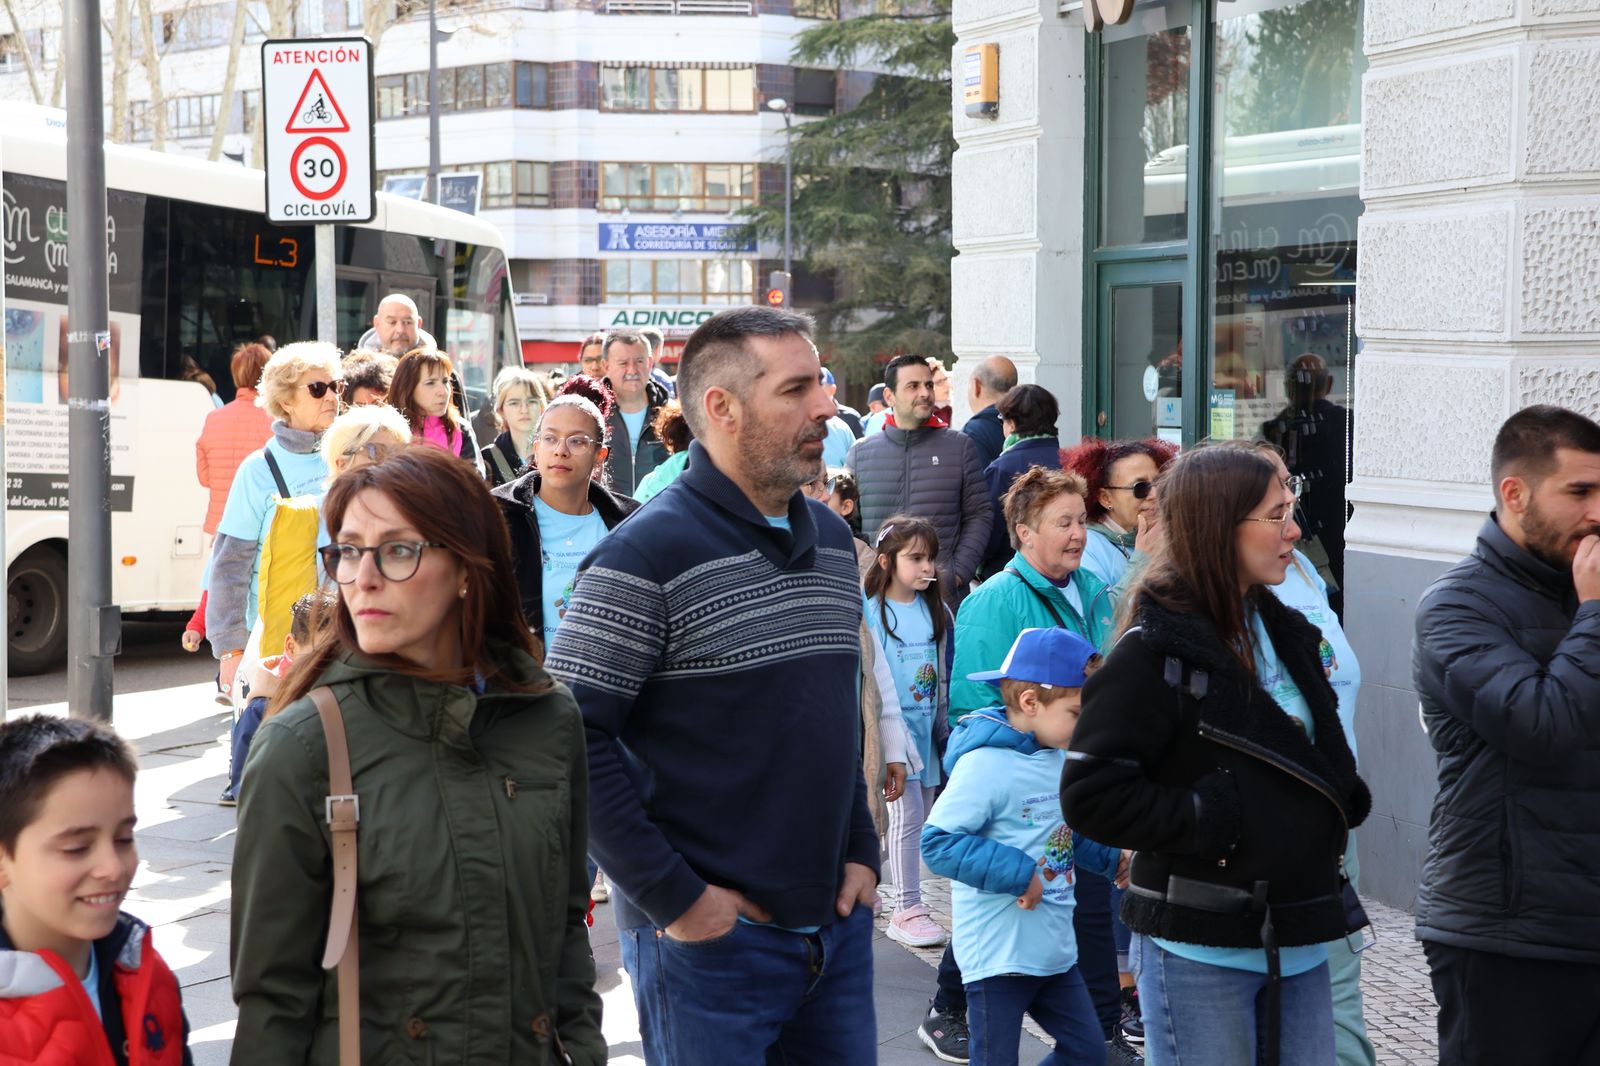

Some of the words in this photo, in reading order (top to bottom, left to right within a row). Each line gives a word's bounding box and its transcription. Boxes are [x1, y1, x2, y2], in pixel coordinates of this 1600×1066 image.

[273, 46, 360, 65] ATENCIÓN
[303, 158, 335, 178] 30
[283, 202, 357, 217] CICLOVÍA
[634, 224, 698, 238] ASESORÍA
[634, 240, 692, 250] CORREDURÍA
[694, 240, 706, 250] DE
[5, 273, 54, 291] SALAMANCA
[13, 478, 23, 489] 32
[10, 495, 21, 506] del
[22, 496, 47, 508] Corpus,
[48, 496, 57, 506] 41
